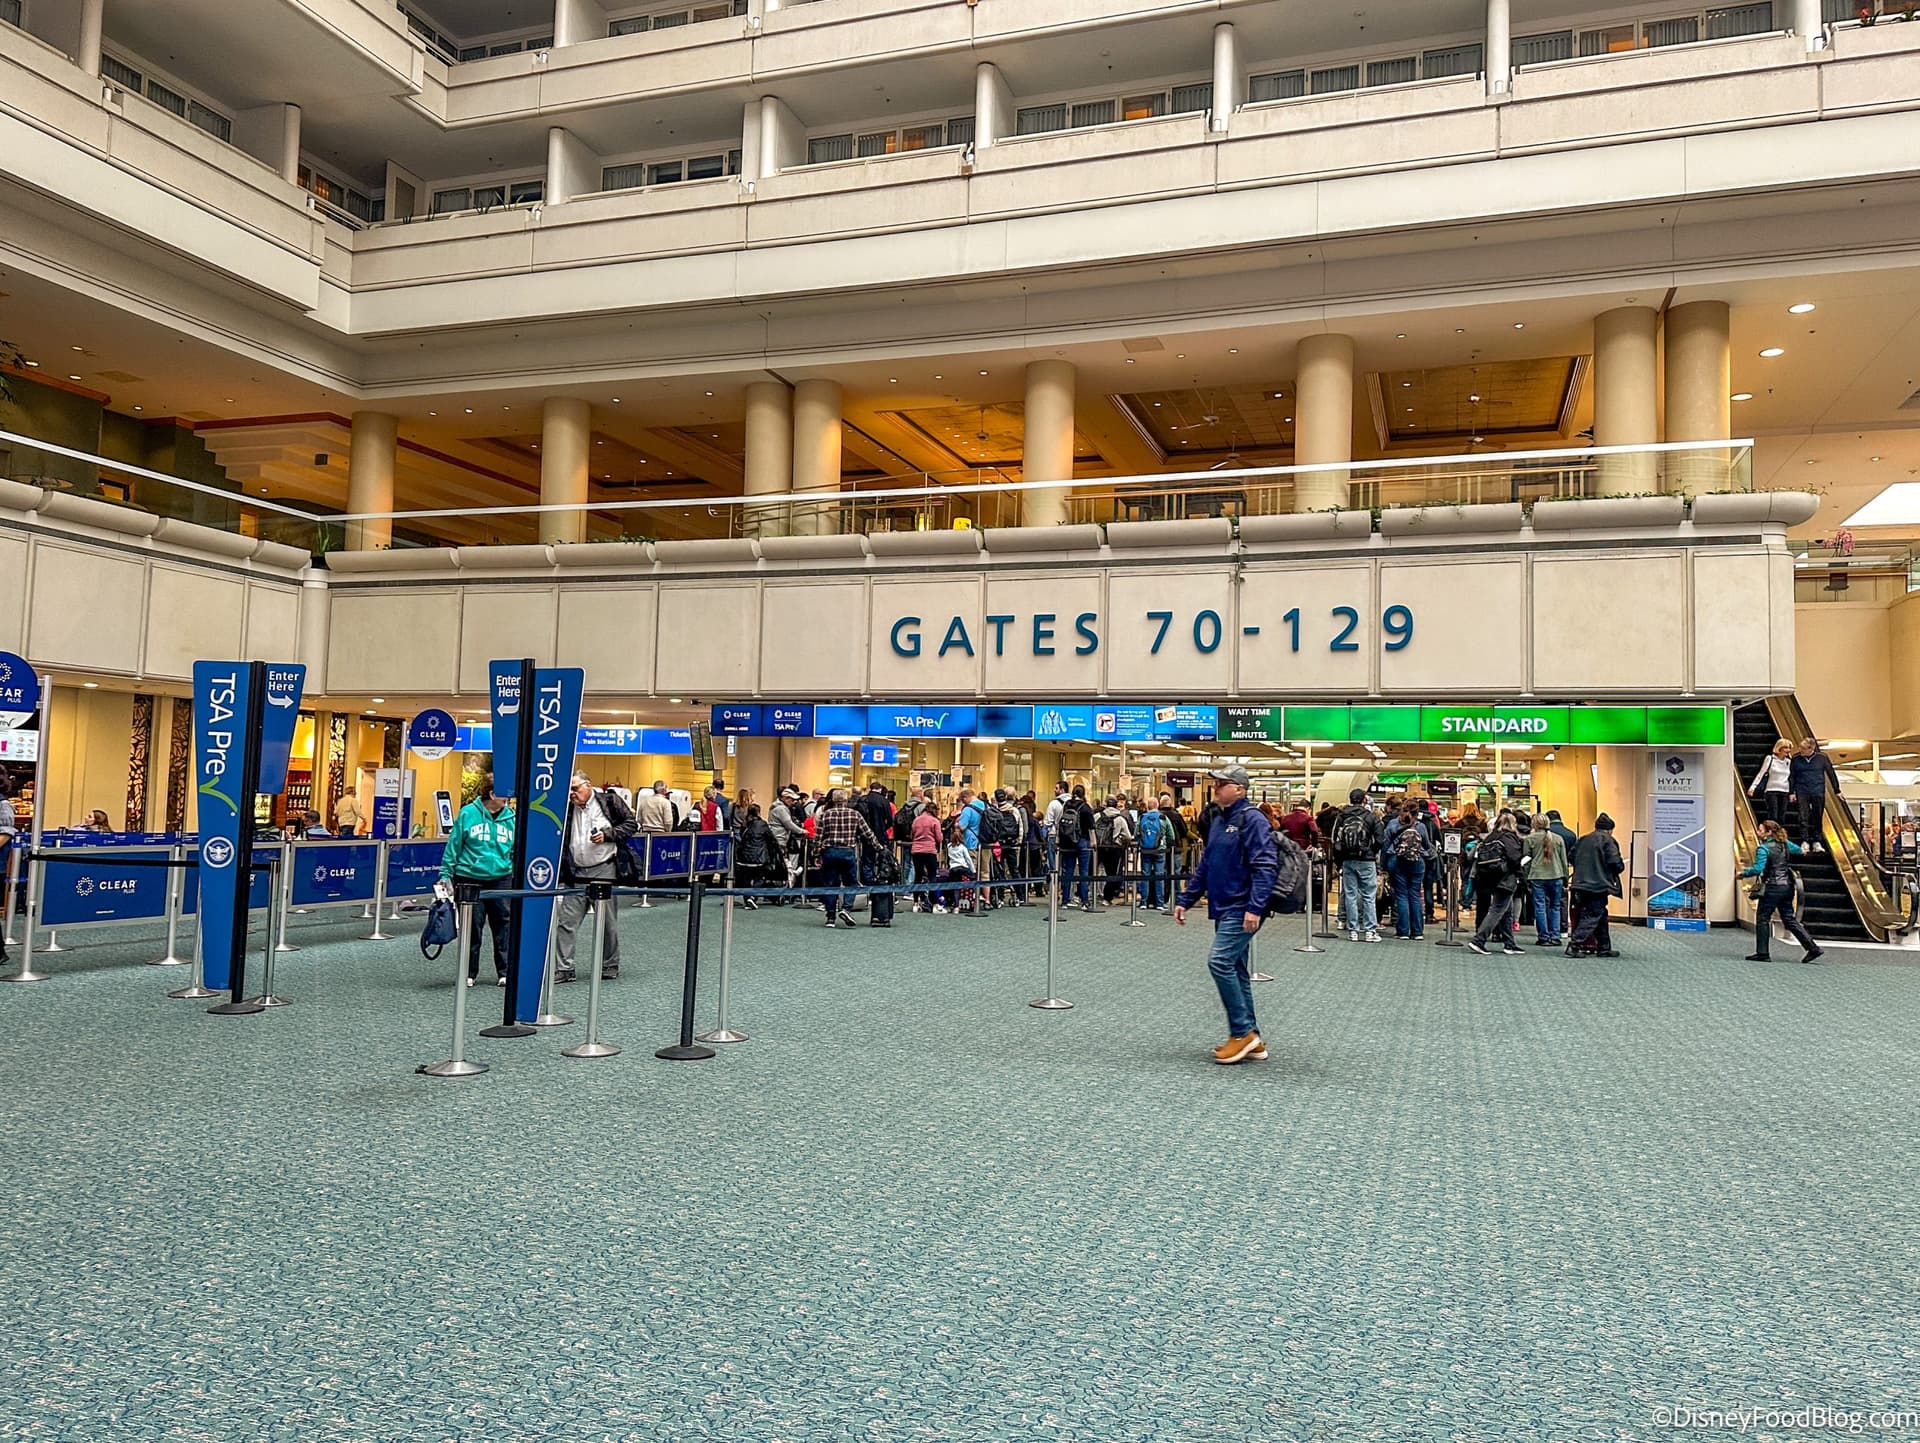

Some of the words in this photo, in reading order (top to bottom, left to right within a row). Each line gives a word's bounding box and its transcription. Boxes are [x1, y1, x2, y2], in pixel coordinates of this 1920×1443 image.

[890, 612, 1099, 658] GATES
[268, 670, 300, 682] Enter
[496, 675, 521, 686] Enter
[268, 681, 295, 692] Here
[208, 672, 237, 724] TSA
[498, 687, 521, 698] Here
[538, 680, 562, 736] TSA
[1228, 708, 1249, 716] WAIT
[1250, 708, 1271, 716] TIME
[894, 716, 914, 728] TSA
[915, 716, 934, 728] Pre
[1237, 719, 1243, 728] 5
[1255, 719, 1261, 728] 9
[1441, 717, 1548, 733] STANDARD
[1231, 731, 1268, 739] MINUTES
[205, 731, 232, 775] Pre
[829, 750, 839, 760] ot
[535, 744, 558, 791] Pre
[330, 868, 355, 877] CLEAR
[99, 879, 137, 890] CLEAR
